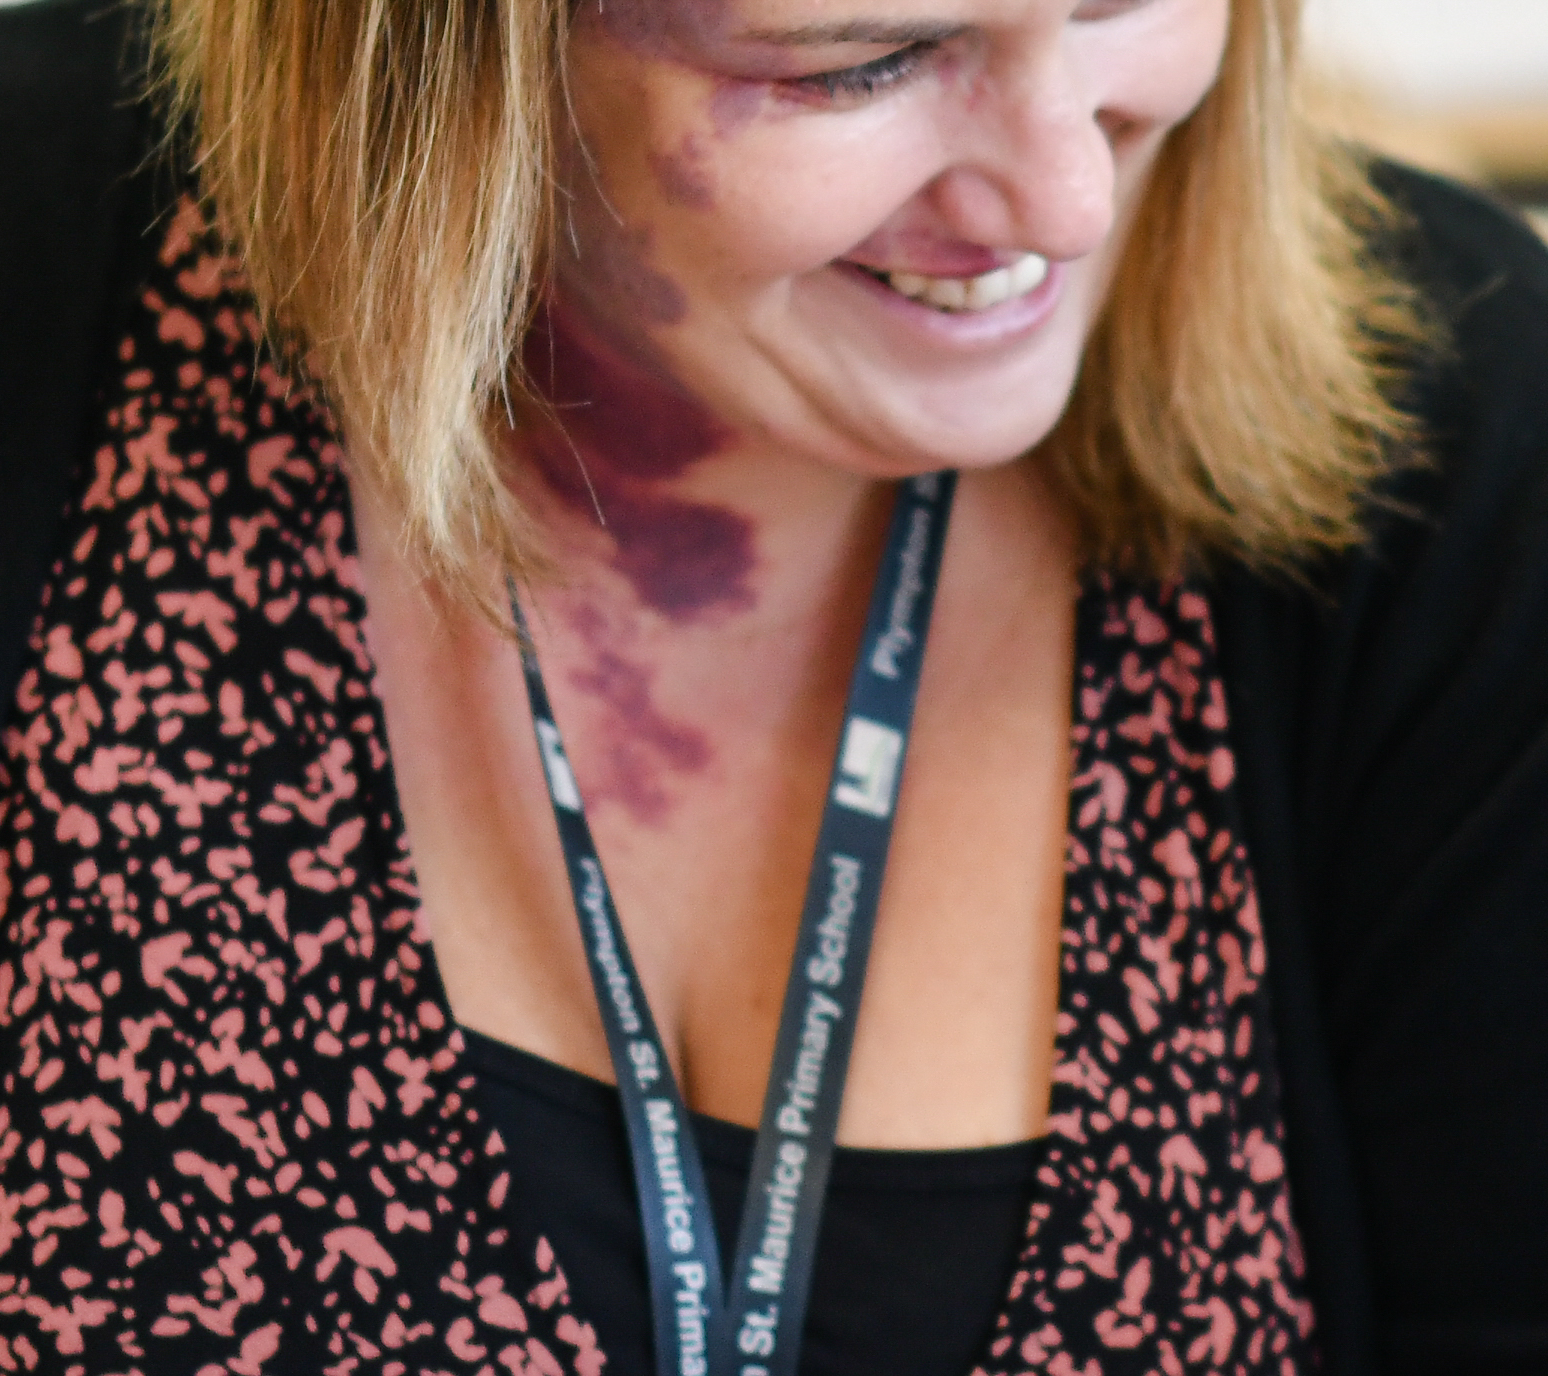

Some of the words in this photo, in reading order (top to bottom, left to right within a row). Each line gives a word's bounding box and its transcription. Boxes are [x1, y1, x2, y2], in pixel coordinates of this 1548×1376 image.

[872, 508, 932, 679] Plympton
[807, 851, 863, 987] School
[580, 856, 640, 1034] Plympton
[628, 1039, 660, 1091] St.
[645, 1098, 695, 1254] Maurice
[775, 990, 844, 1137] Primary
[748, 1141, 809, 1295] Maurice
[738, 1303, 779, 1357] St.
